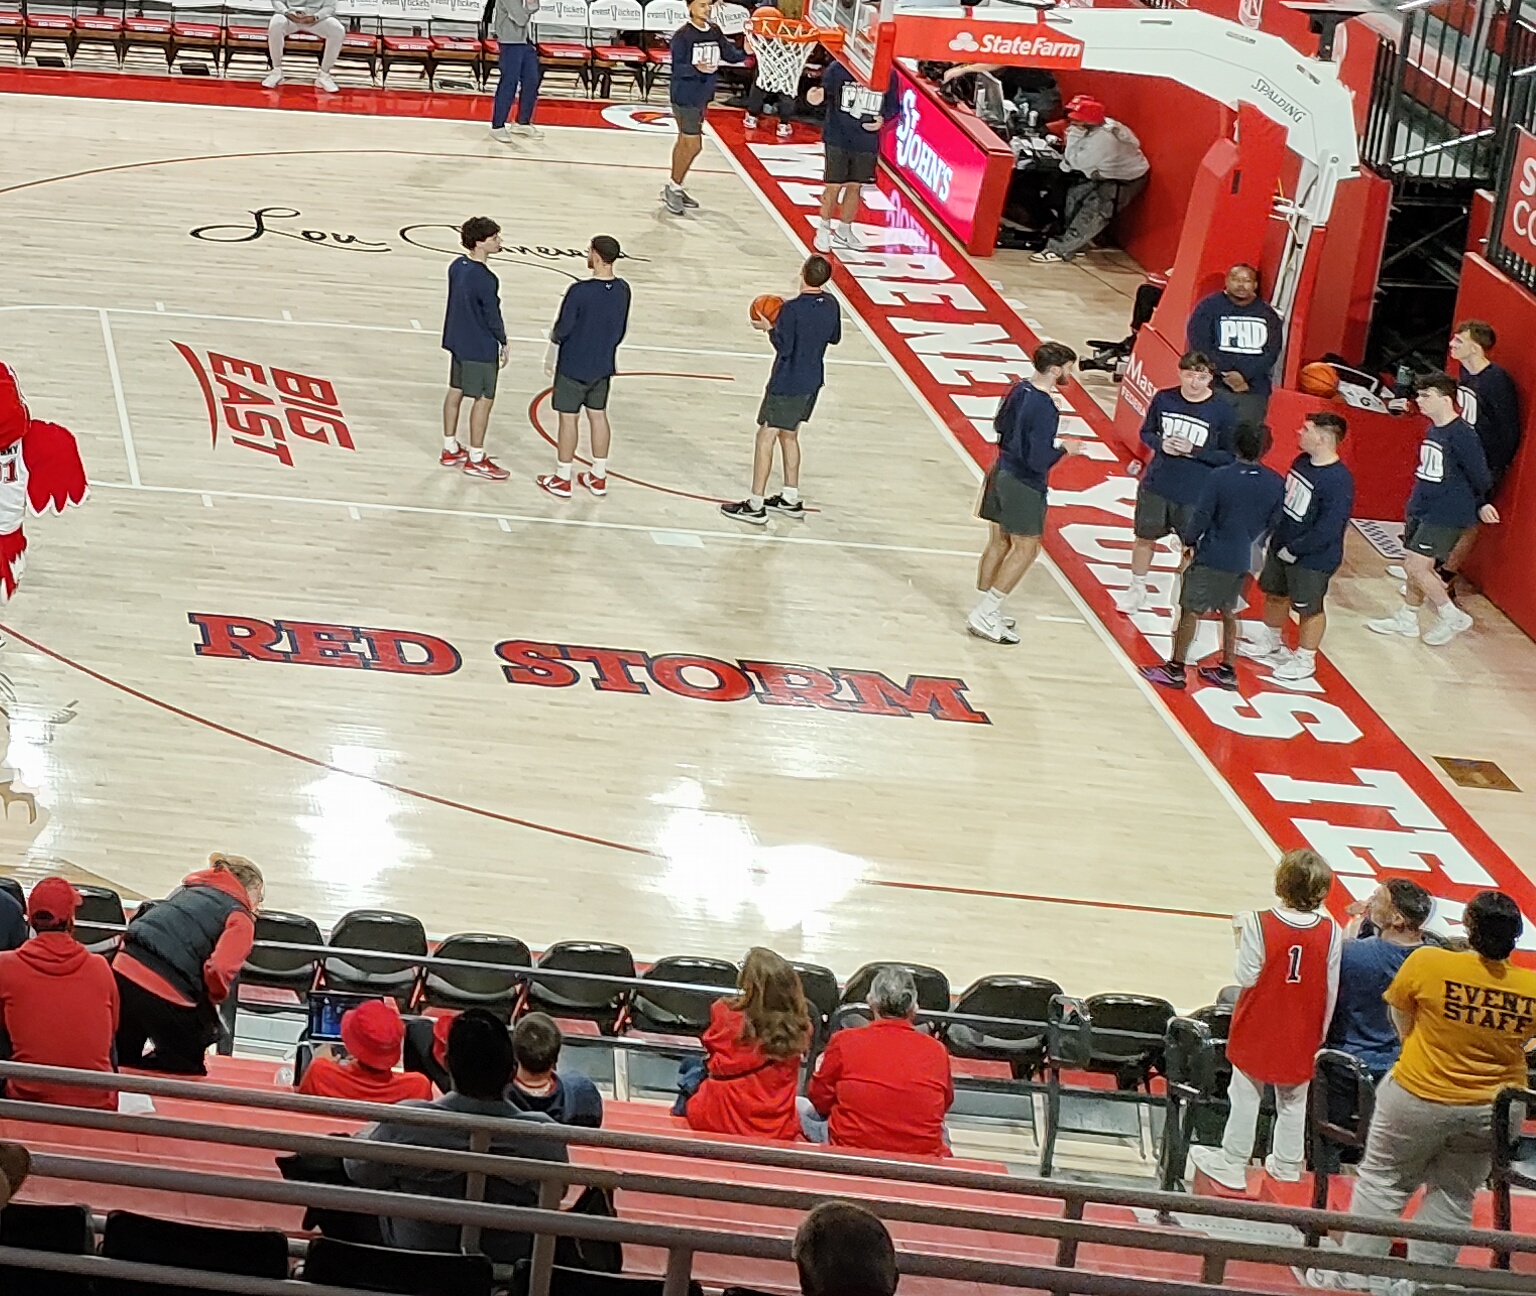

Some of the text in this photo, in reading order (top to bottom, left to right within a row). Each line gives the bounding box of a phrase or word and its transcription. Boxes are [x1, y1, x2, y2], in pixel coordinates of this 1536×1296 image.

[1250, 78, 1307, 125] SPALDING
[190, 205, 393, 253] Lou
[1219, 318, 1269, 351] PHD
[207, 350, 294, 467] EAST
[269, 365, 355, 451] BIG
[188, 611, 993, 726] RED STORM
[1286, 945, 1303, 984] 1
[1443, 1001, 1534, 1035] STAFF
[1444, 979, 1536, 1015] EVENT
